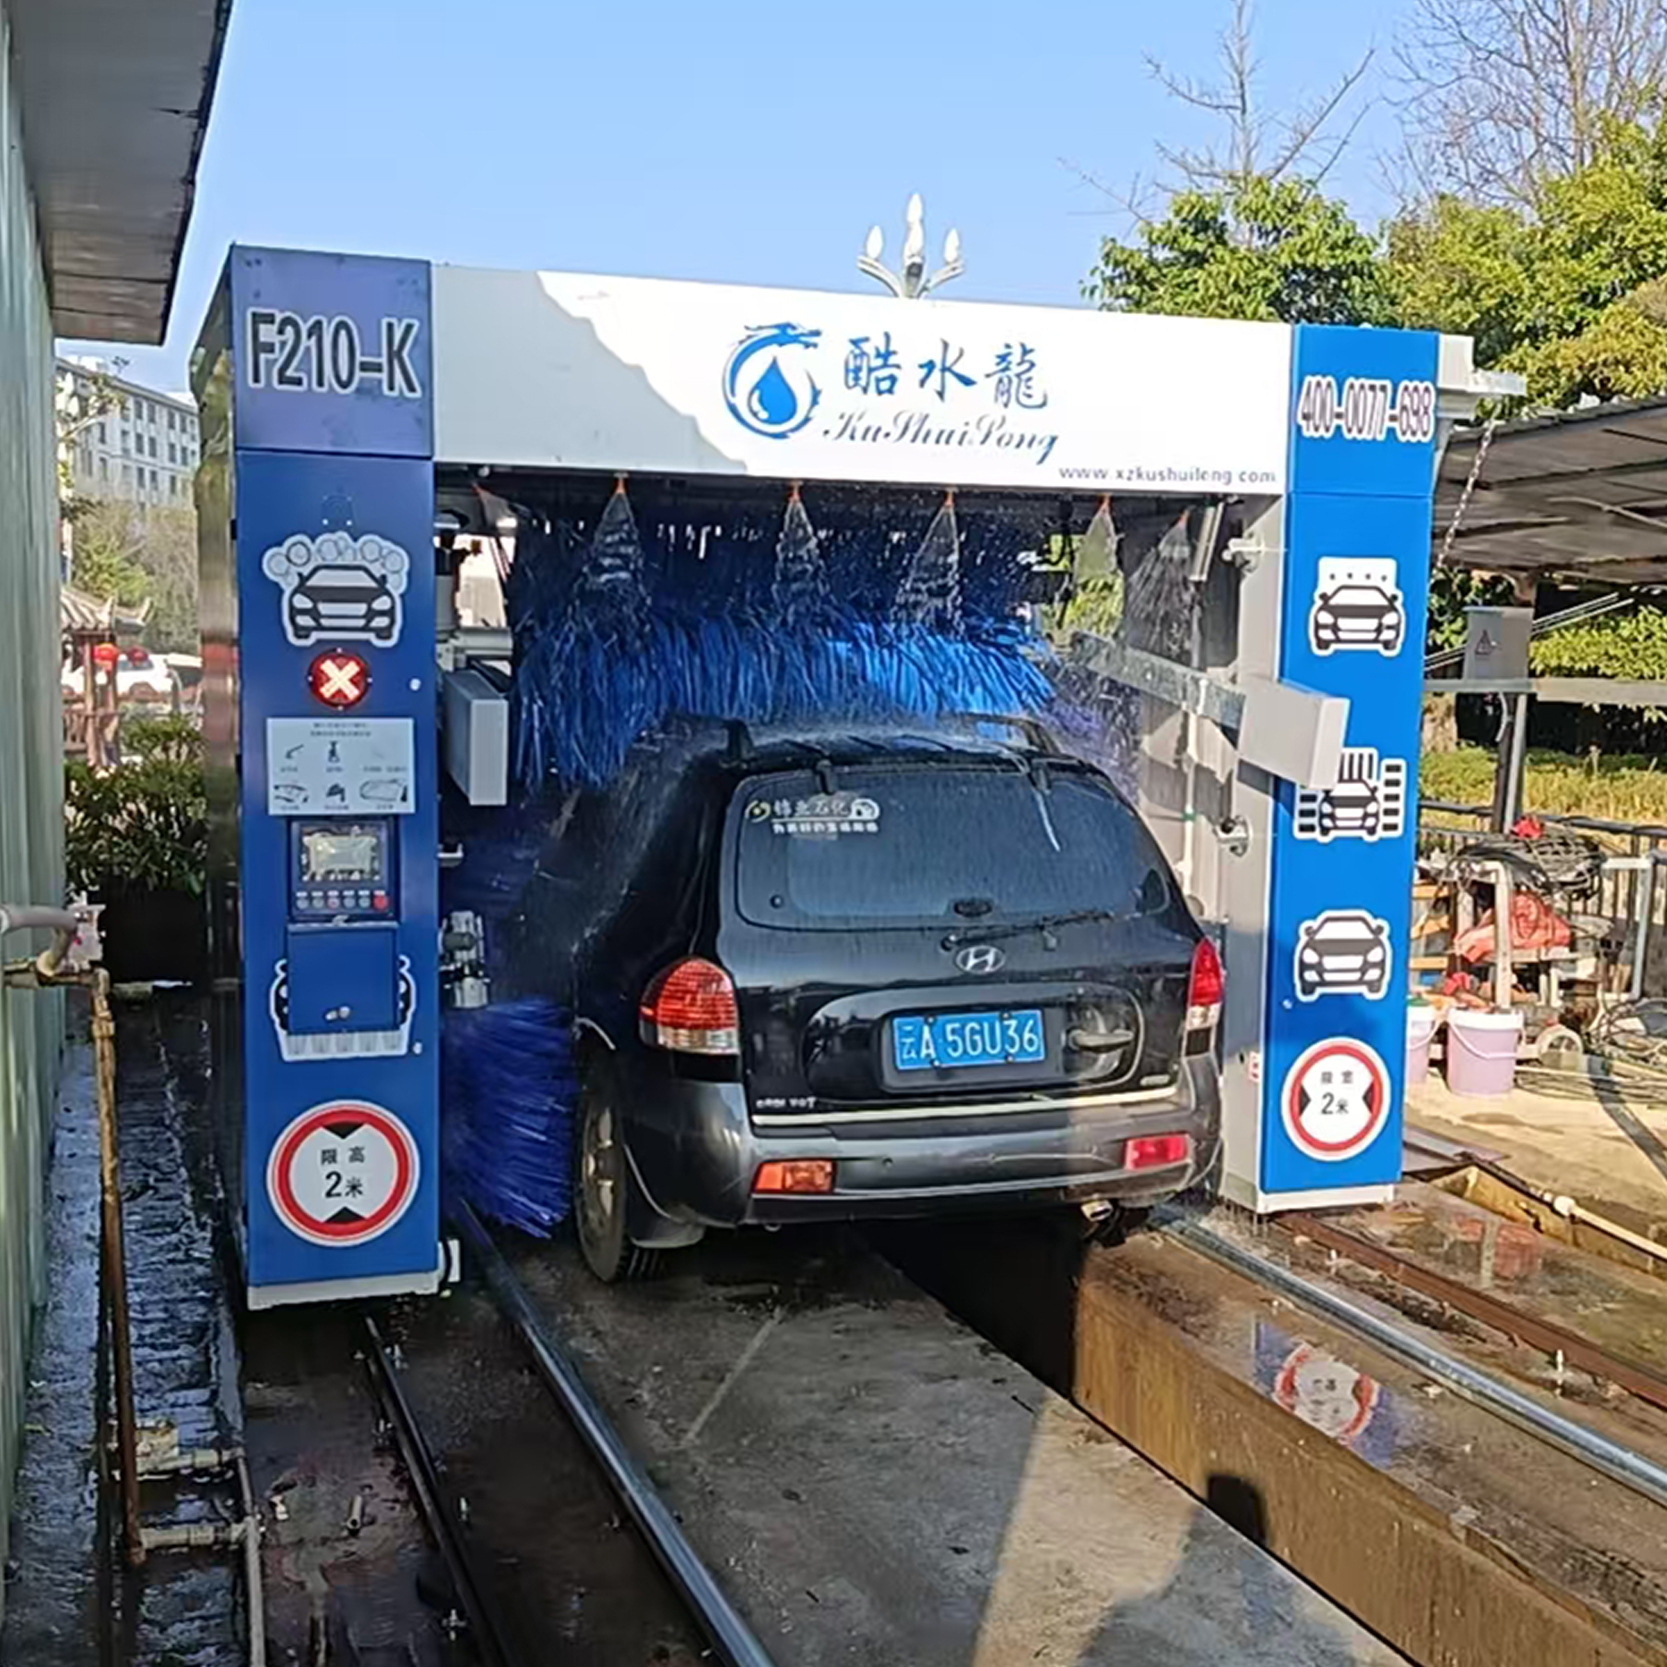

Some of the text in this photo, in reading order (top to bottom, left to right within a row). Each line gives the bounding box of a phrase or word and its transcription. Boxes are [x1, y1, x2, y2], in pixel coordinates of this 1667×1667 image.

[249, 309, 420, 396] F210-K
[844, 331, 1048, 409] 酷水龍
[1299, 378, 1433, 440] 400-0077-698
[945, 1019, 1040, 1058] 5GU36
[1320, 1091, 1349, 1116] 2米
[320, 1146, 366, 1166] 限高
[325, 1171, 364, 1199] 2米
